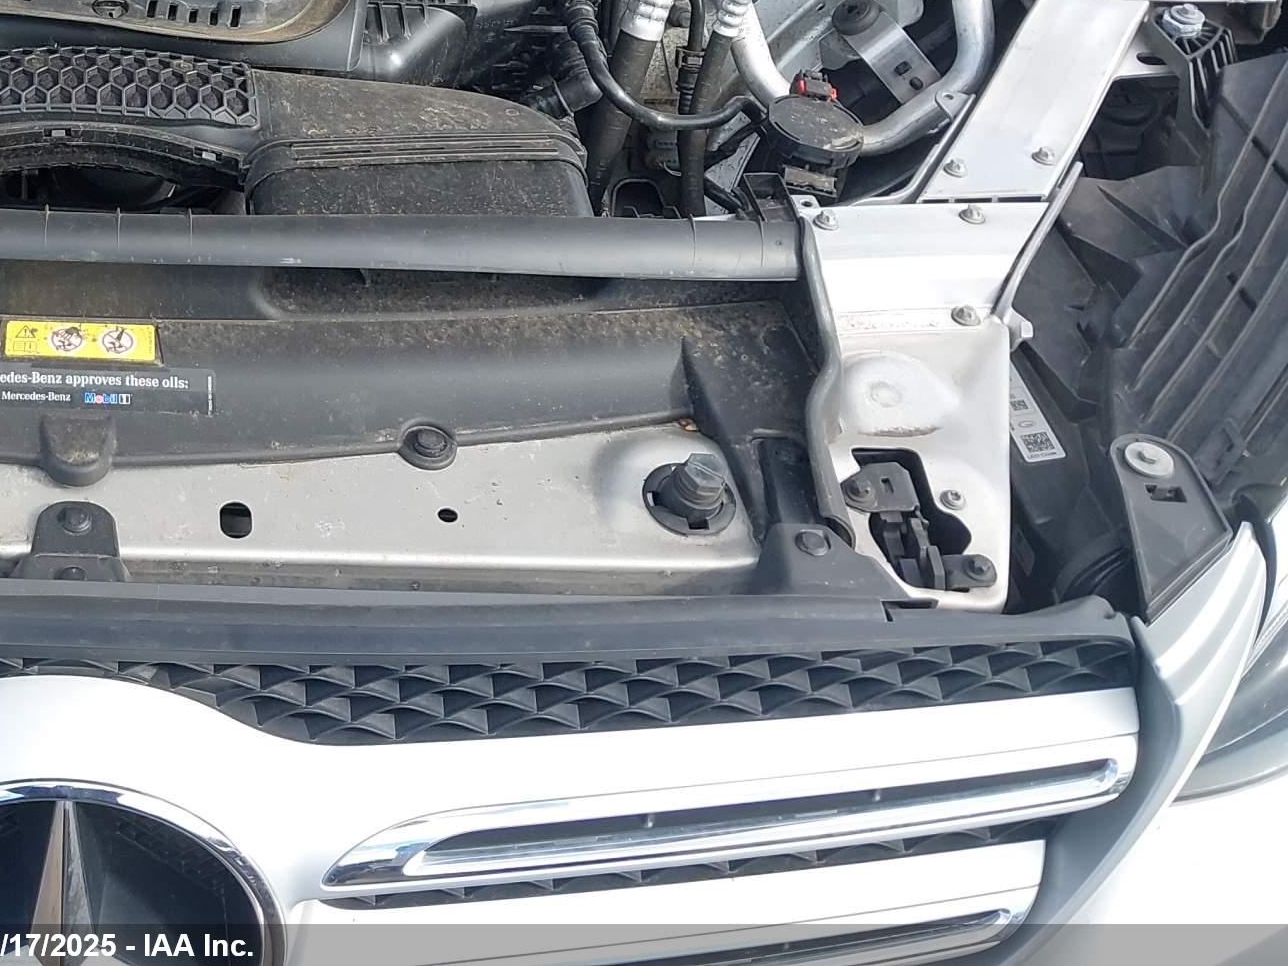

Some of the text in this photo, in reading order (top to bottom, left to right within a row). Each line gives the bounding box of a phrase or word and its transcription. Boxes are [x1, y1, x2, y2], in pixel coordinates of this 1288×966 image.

[65, 374, 122, 387] approves
[125, 375, 160, 388] these
[162, 376, 189, 389] oils:
[1, 391, 72, 402] Mercedes-Benz
[84, 392, 118, 404] Mobil
